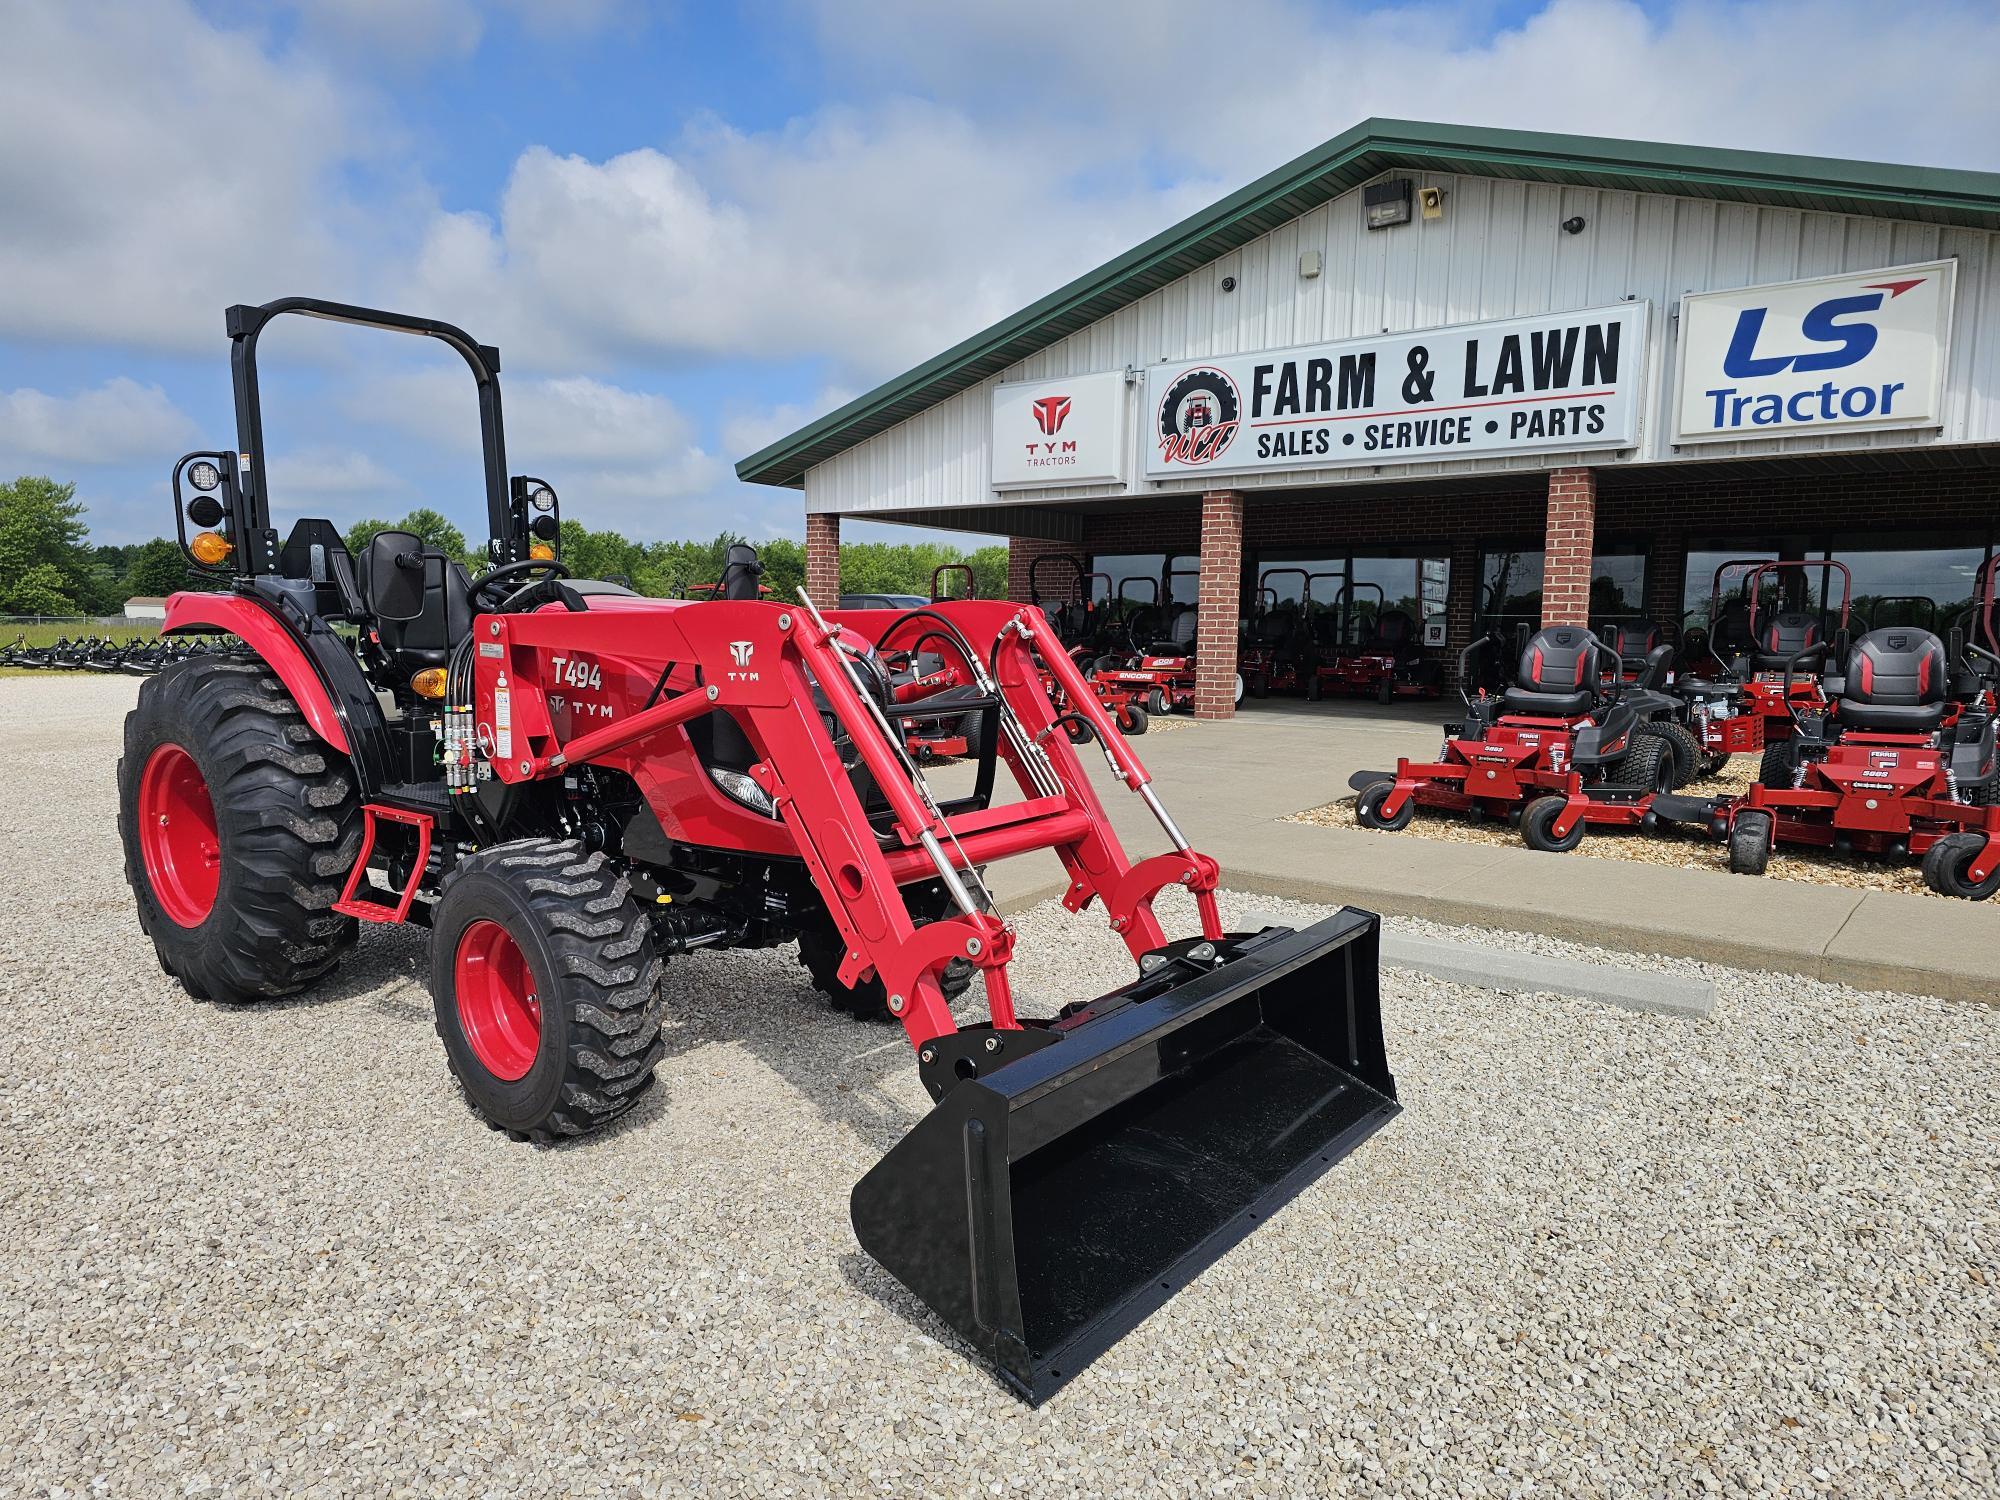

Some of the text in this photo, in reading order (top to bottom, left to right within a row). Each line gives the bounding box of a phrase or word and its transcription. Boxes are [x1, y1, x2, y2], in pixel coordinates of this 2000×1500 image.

[1723, 292, 1884, 379] LS
[1252, 322, 1621, 418] FARM & LAWN
[1705, 381, 1905, 428] Tractor
[1257, 404, 1605, 459] SALES SERVICE PARTS
[1025, 440, 1077, 455] TYM
[1026, 455, 1076, 468] TRACTORS
[551, 656, 602, 691] T494
[727, 672, 759, 681] TYM
[1119, 672, 1153, 680] ENCORE
[572, 701, 613, 718] TYM
